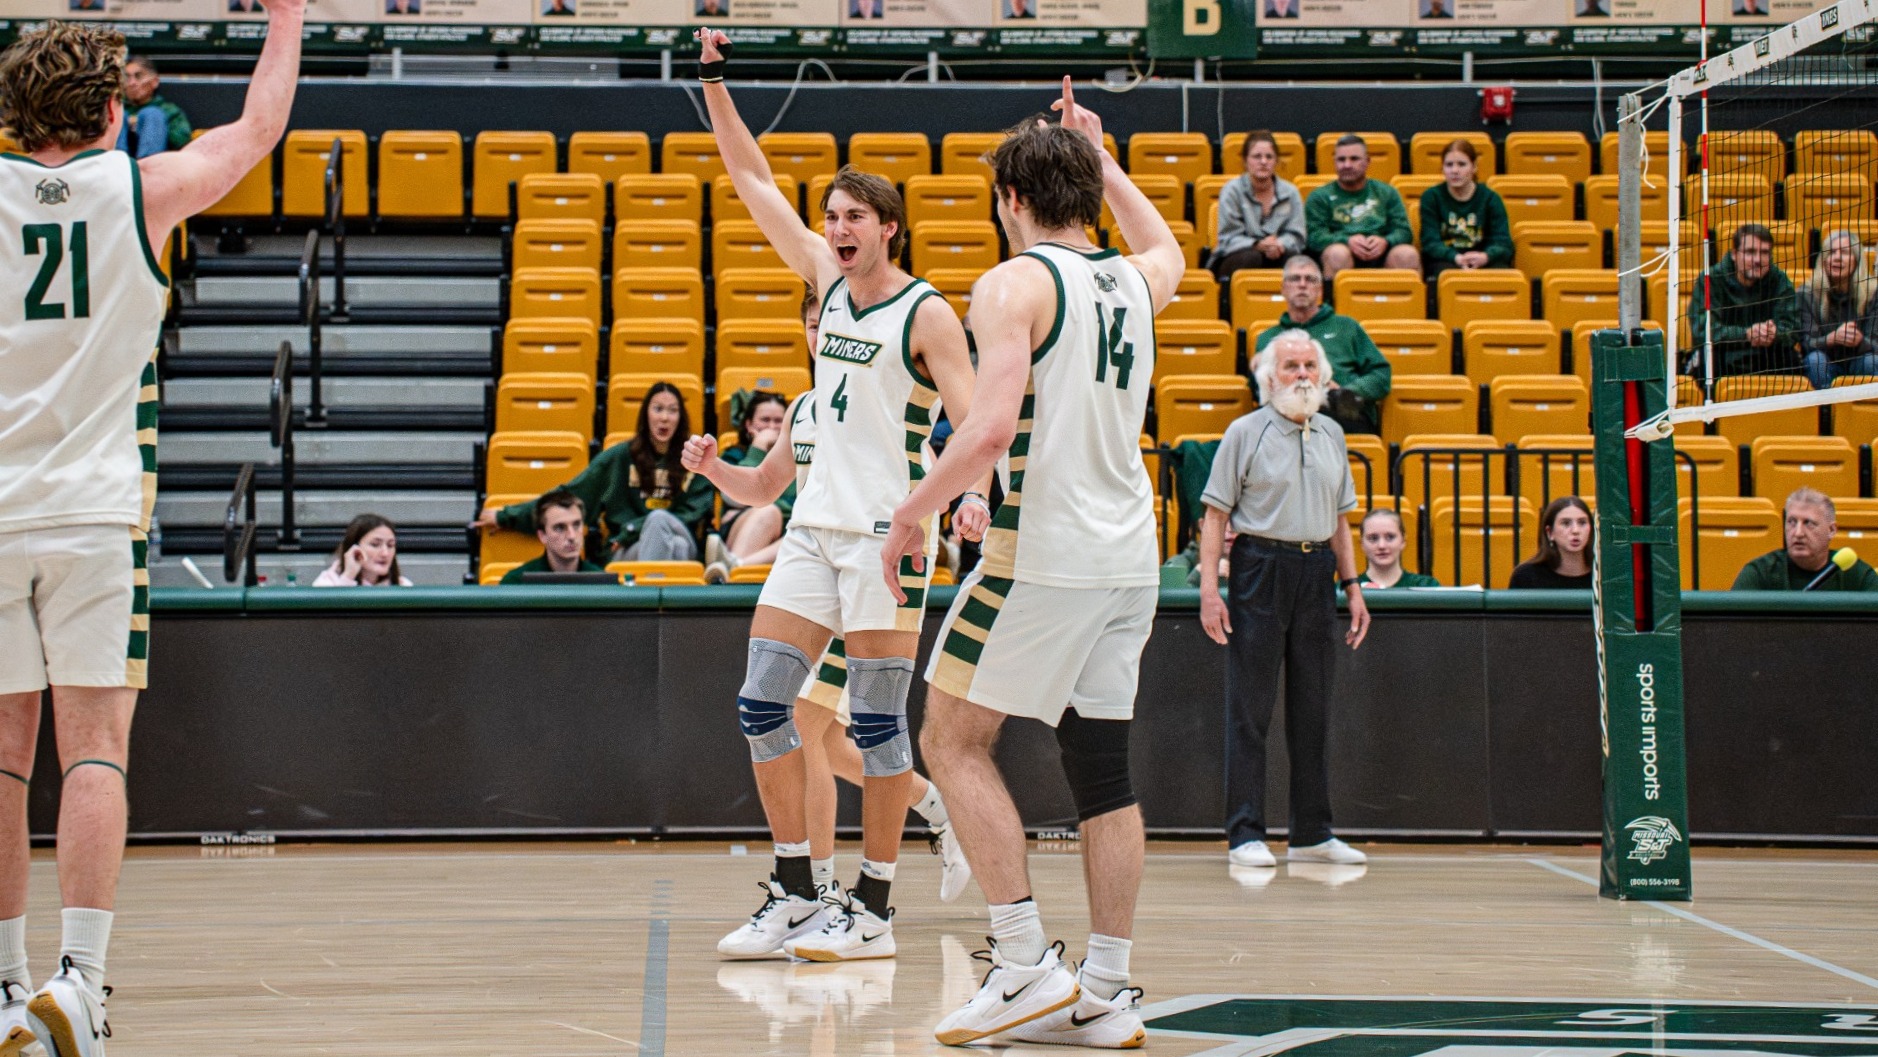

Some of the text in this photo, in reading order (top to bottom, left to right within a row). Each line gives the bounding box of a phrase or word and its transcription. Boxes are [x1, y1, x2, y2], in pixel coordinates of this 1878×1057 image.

[22, 221, 91, 321] 21
[827, 336, 878, 361] MINERS
[1094, 300, 1135, 390] 14
[830, 373, 848, 422] 4
[1636, 663, 1661, 800] sports imports
[1633, 831, 1669, 839] MISSOURI
[1638, 839, 1669, 850] S&T
[1630, 878, 1648, 887] (800)
